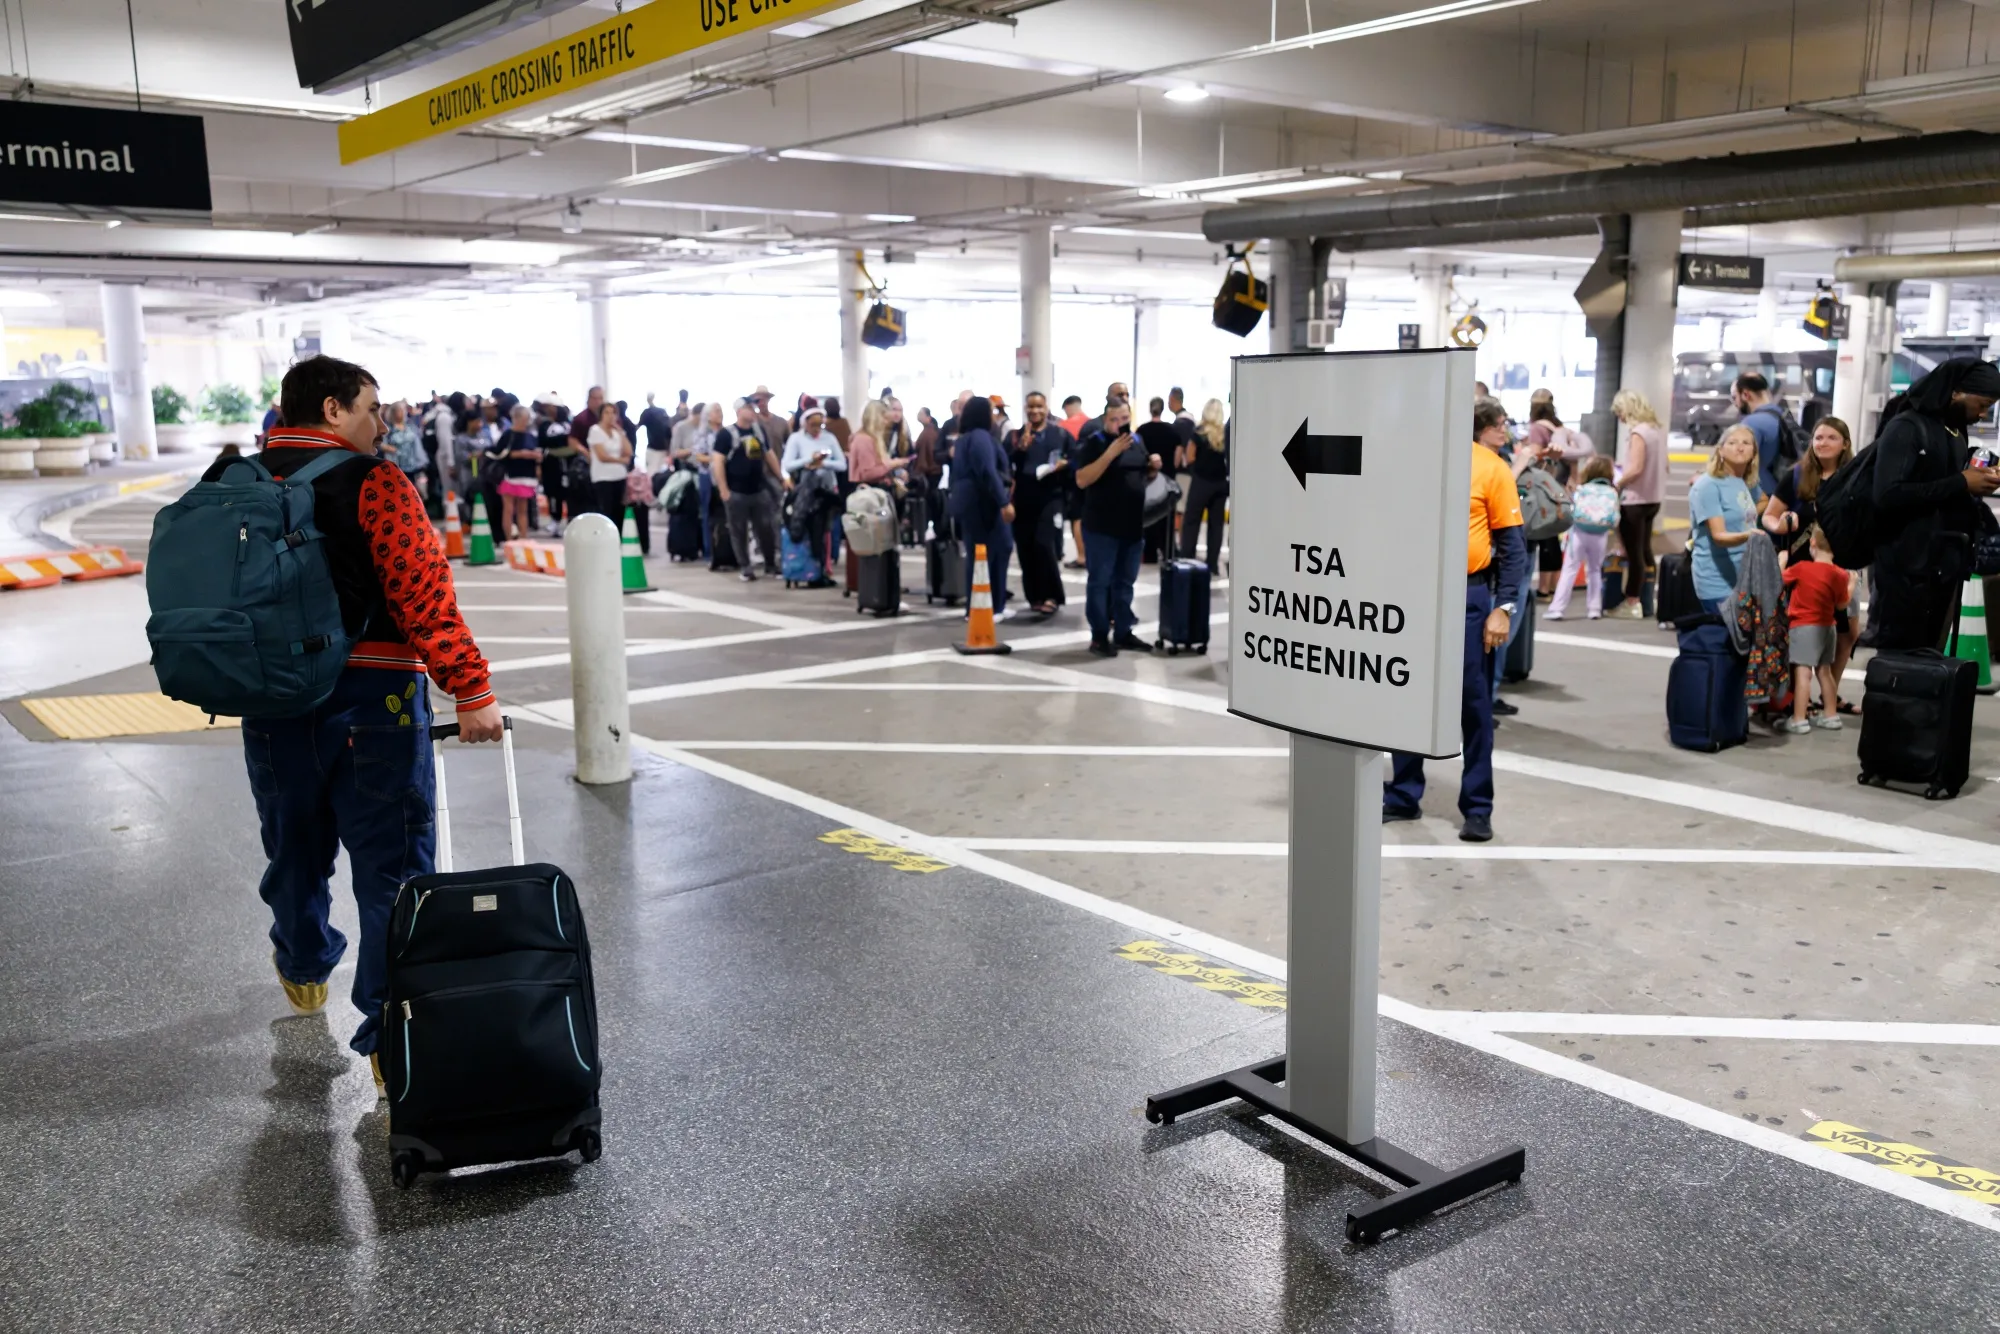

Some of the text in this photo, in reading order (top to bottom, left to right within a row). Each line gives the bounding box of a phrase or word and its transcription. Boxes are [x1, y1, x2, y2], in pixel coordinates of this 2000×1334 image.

[428, 0, 738, 126] CAUTION: CROSSING TRAFFIC USE
[0, 140, 135, 174] rminal
[1715, 264, 1750, 280] Terminal
[1291, 543, 1346, 577] TSA
[1248, 585, 1405, 635] STANDARD
[1243, 631, 1410, 687] SCREENING
[1136, 946, 1194, 970] WATCH
[1195, 967, 1242, 989] YOUR
[1830, 1130, 2000, 1196] WATCH YOU
